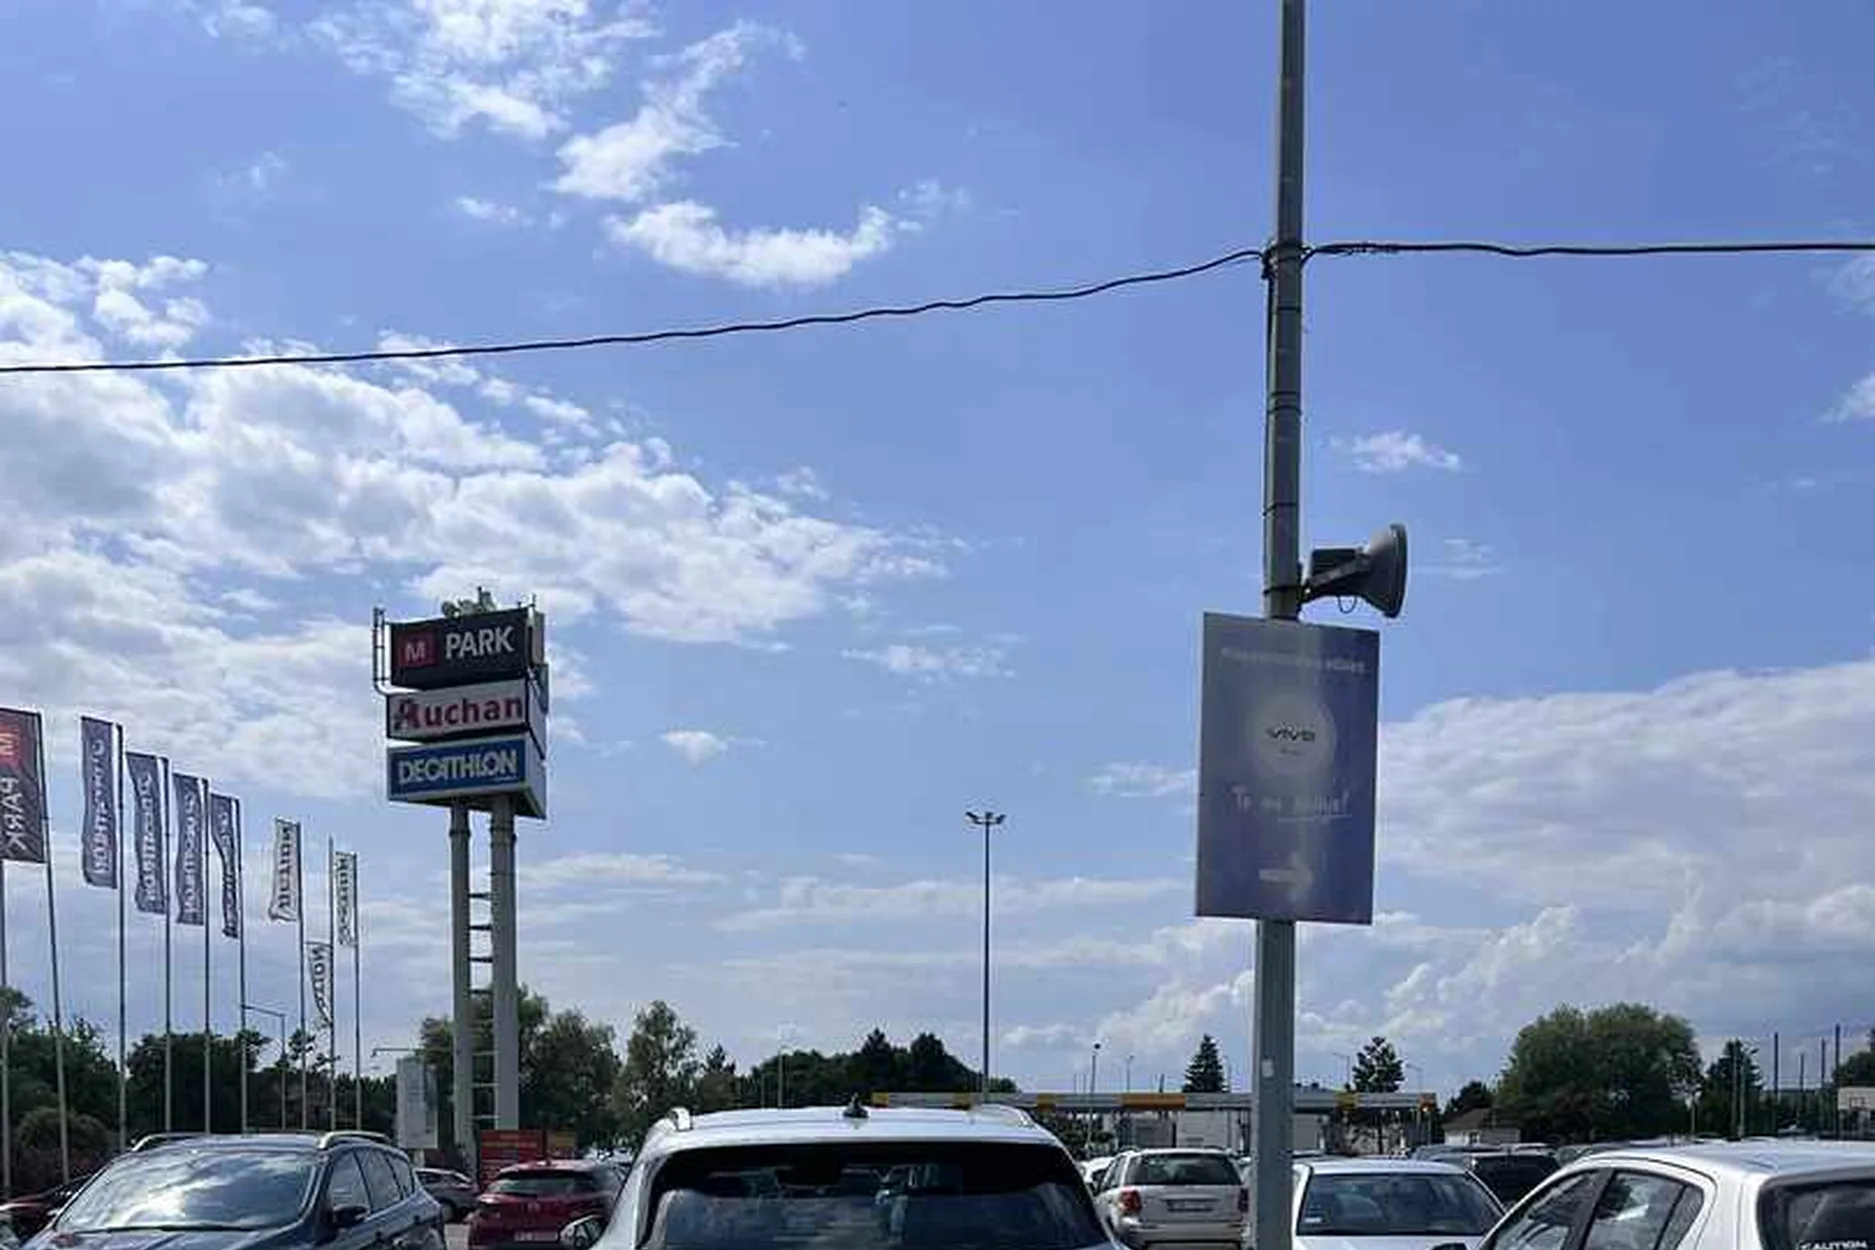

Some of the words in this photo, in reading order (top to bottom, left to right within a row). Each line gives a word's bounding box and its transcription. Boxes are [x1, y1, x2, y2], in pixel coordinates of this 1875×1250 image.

[444, 625, 515, 660] PARK
[393, 696, 523, 732] Auchan
[398, 751, 518, 784] DECATHLON
